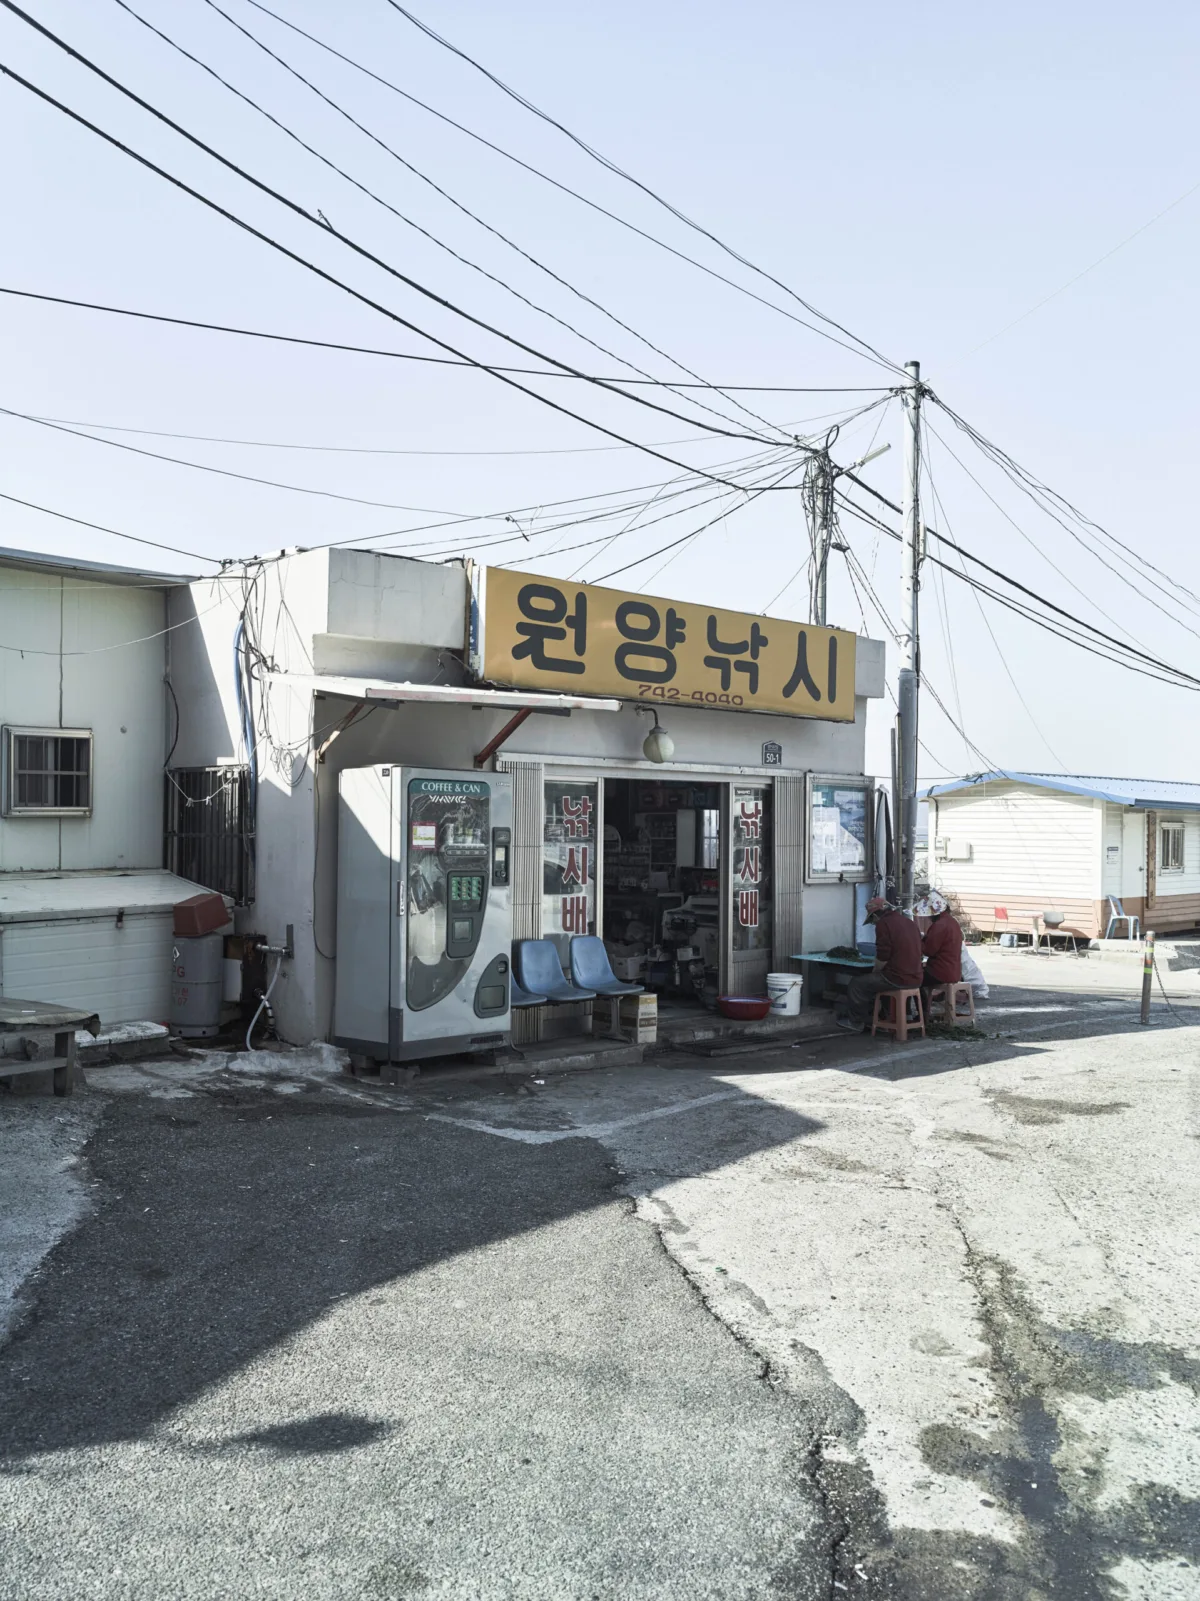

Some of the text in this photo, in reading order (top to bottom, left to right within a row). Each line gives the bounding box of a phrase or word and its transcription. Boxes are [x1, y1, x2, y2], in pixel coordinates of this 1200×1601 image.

[511, 583, 837, 704] 원양낚시
[638, 684, 744, 706] 742-4040
[421, 782, 481, 793] COFFEE & CAN
[766, 753, 779, 763] 50-1
[561, 796, 592, 935] 낚시배
[739, 801, 762, 927] 낚시배
